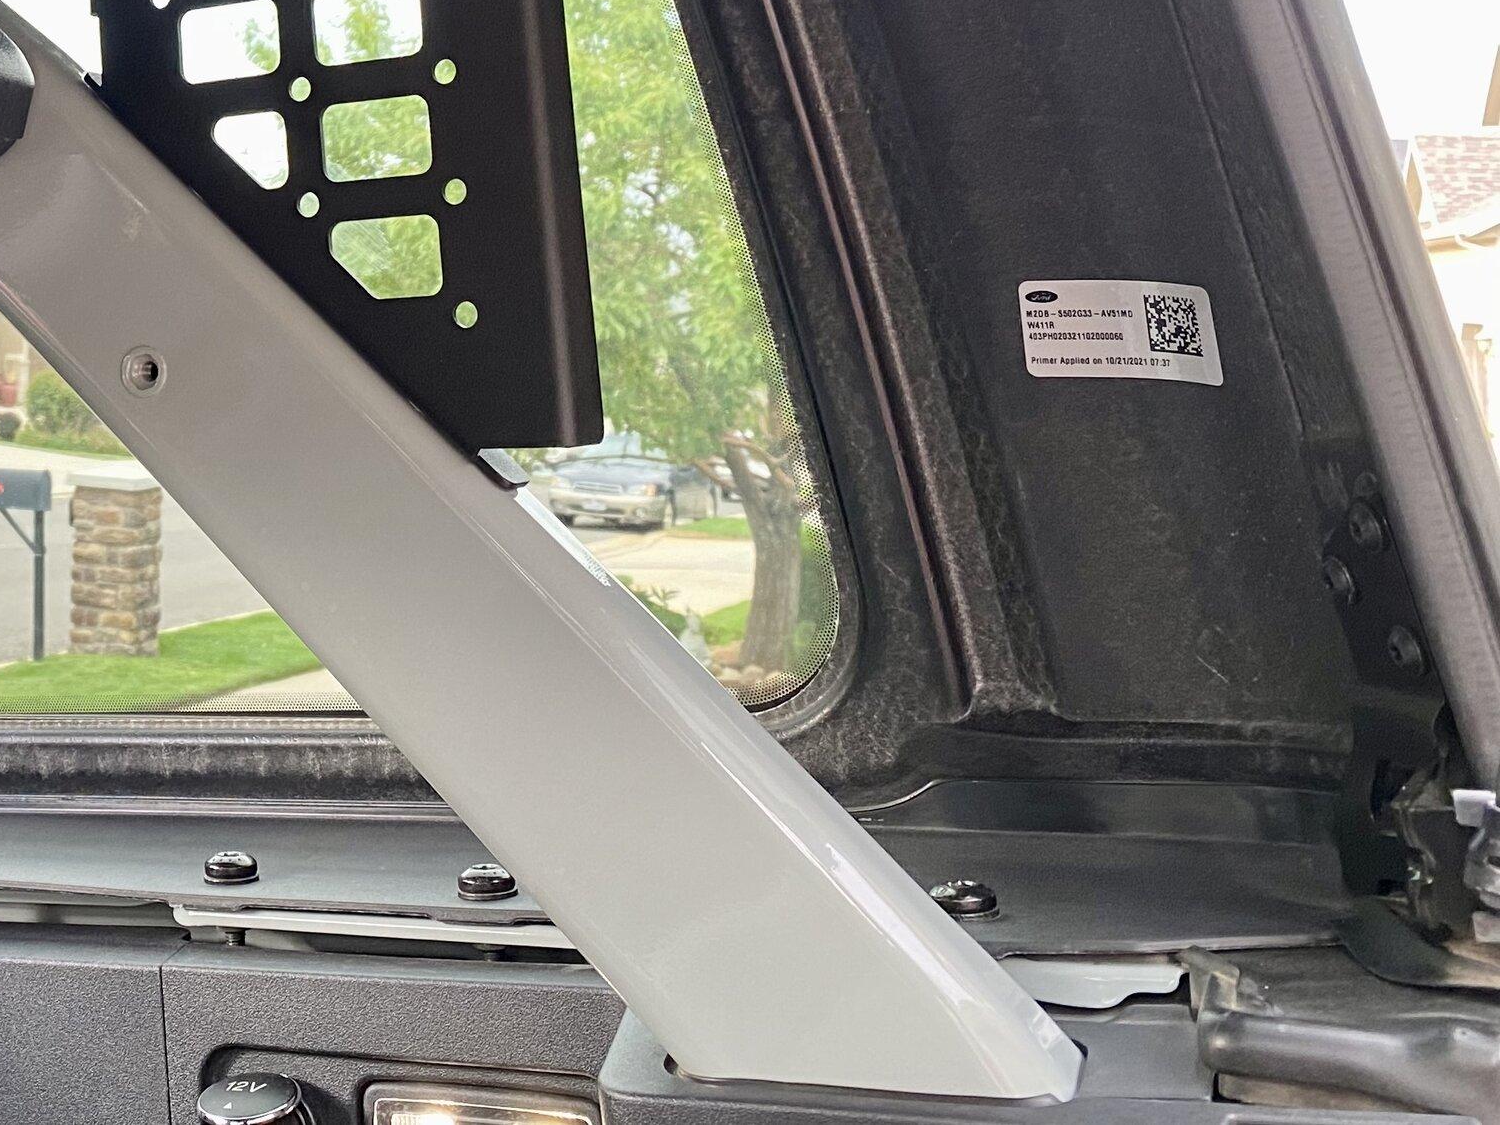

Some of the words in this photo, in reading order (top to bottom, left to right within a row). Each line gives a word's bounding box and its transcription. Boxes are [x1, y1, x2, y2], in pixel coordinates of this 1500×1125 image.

[1027, 321, 1055, 329] W411R
[1031, 356, 1057, 365] Primer
[1060, 356, 1090, 366] Applied
[1092, 357, 1103, 365] on
[1105, 356, 1148, 366] 10/21/2021
[226, 1080, 268, 1093] 12V
